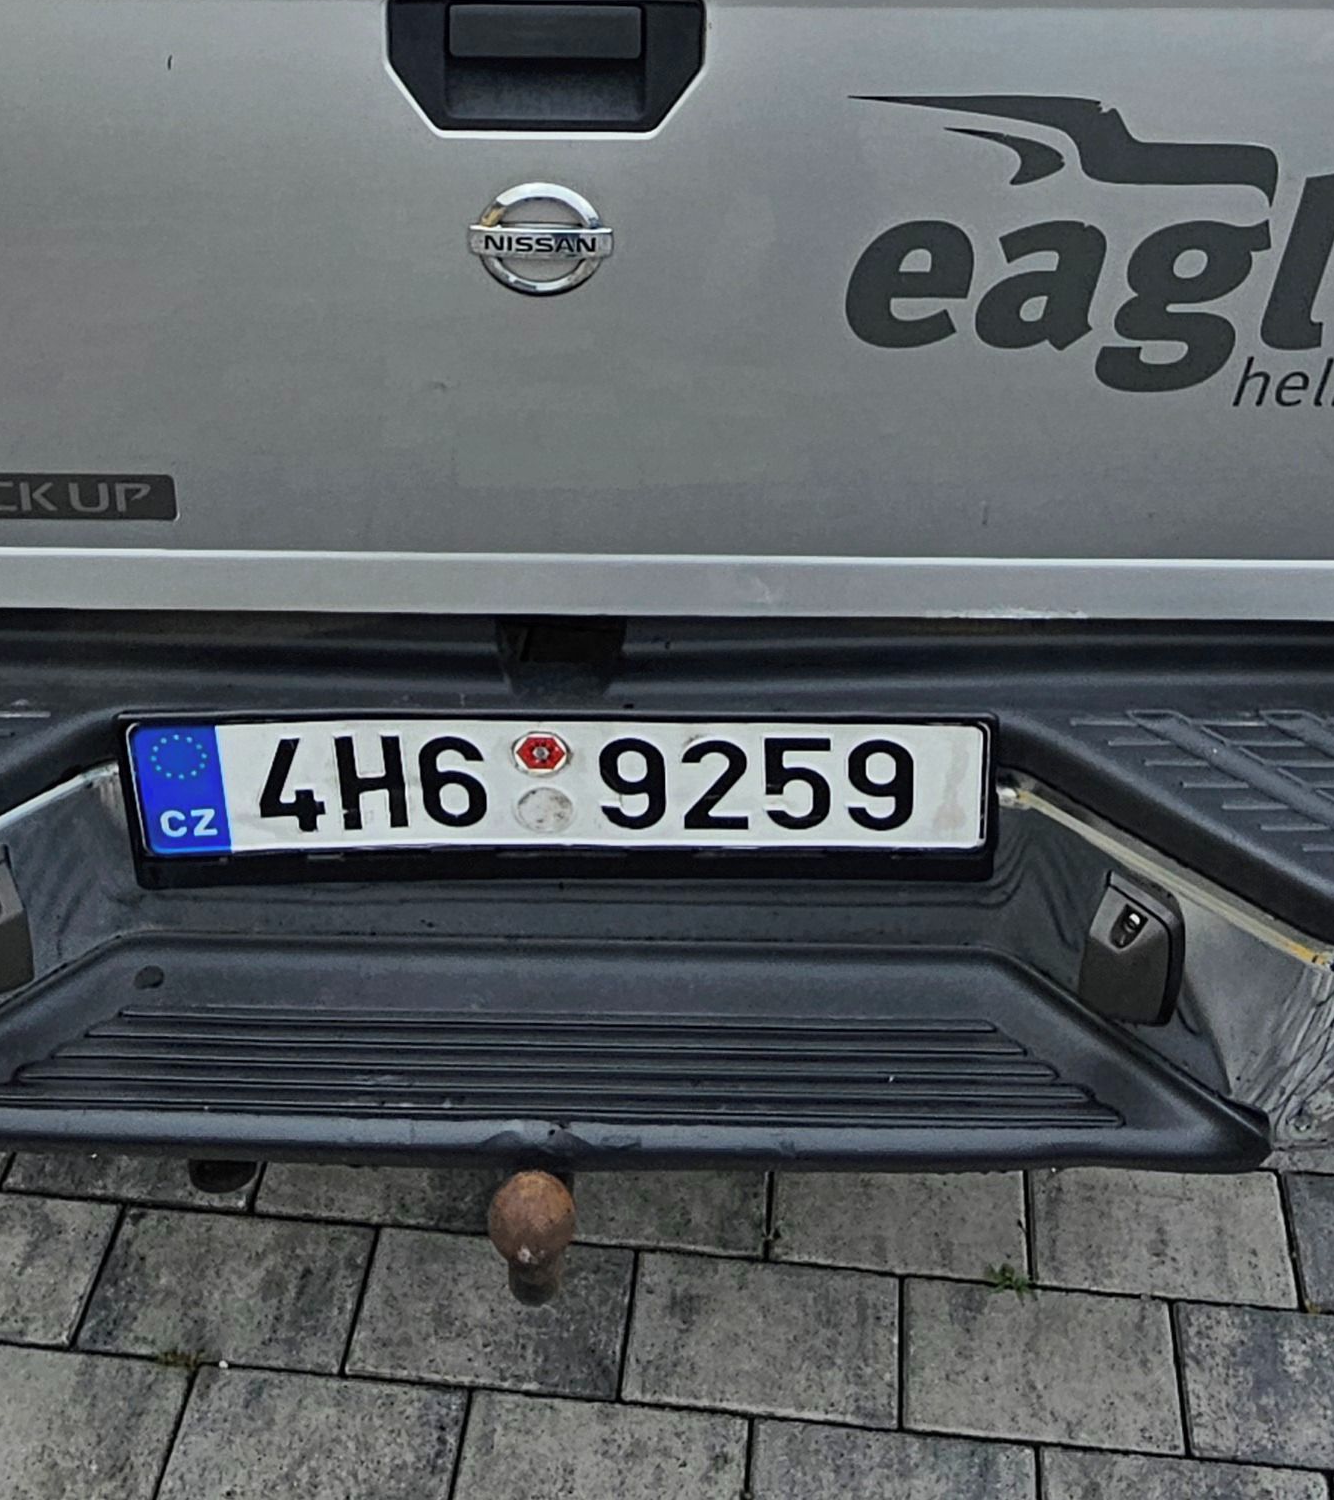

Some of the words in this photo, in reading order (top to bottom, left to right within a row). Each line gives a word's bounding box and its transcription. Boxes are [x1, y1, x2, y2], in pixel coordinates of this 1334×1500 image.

[483, 234, 597, 254] NISSAN
[258, 736, 488, 833] 4H6
[598, 736, 915, 832] 9259
[159, 808, 219, 838] CZ
